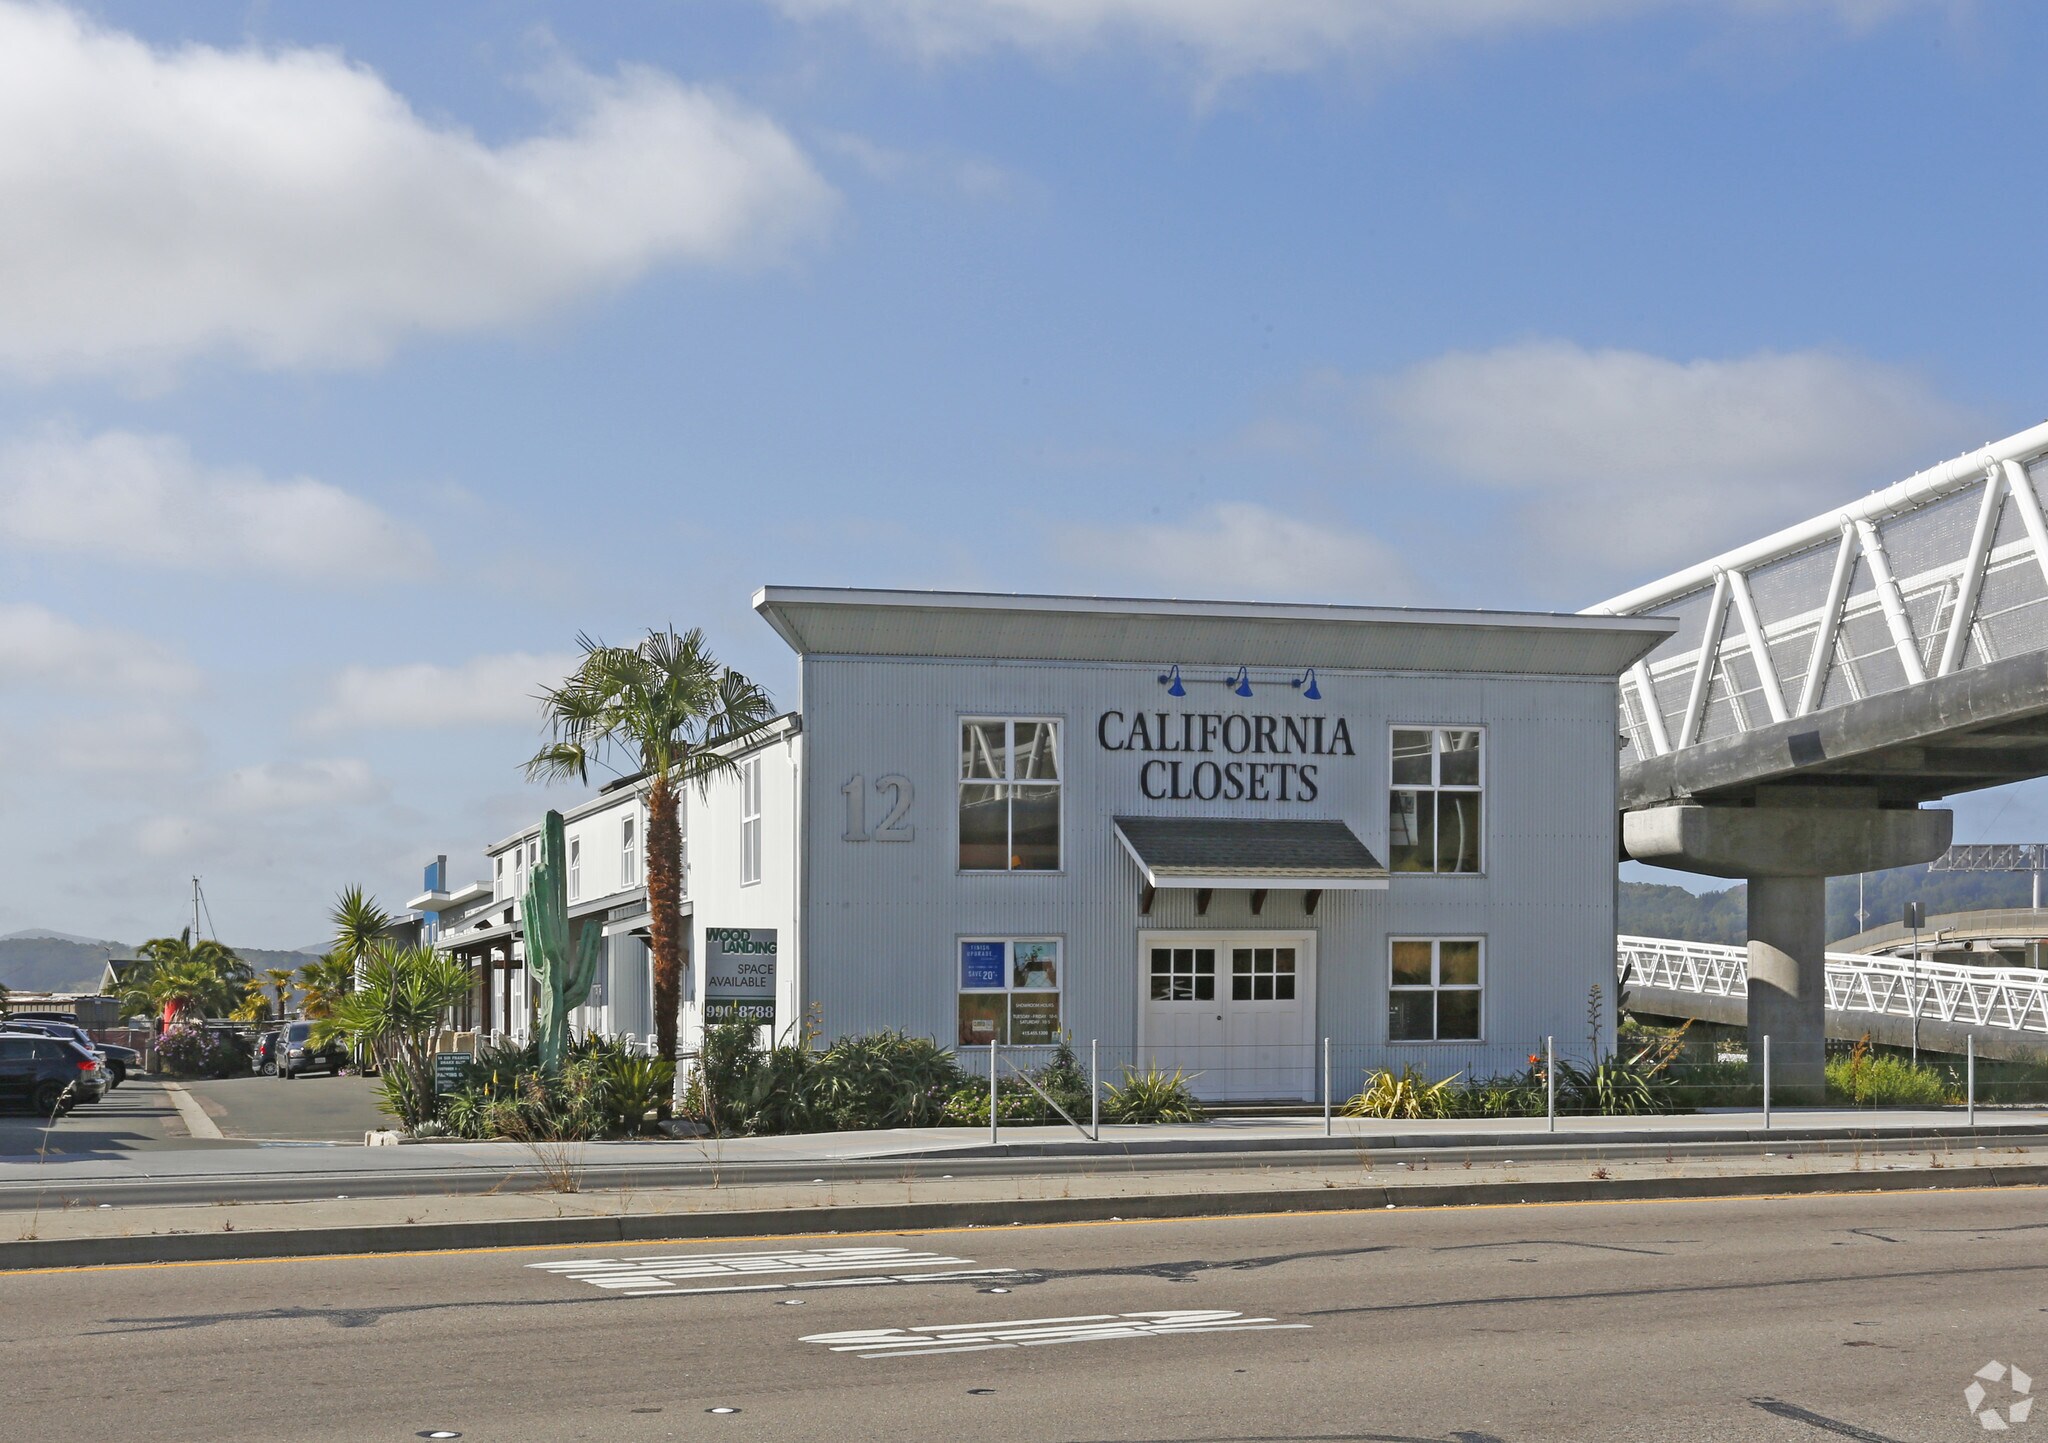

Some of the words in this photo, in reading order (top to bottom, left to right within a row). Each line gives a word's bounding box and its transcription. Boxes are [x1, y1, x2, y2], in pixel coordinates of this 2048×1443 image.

[1098, 710, 1356, 756] CALIFORNIA
[1140, 759, 1318, 802] CLOSETS
[840, 774, 915, 842] 12
[706, 928, 751, 942] WOOD
[721, 941, 777, 955] LANDING
[737, 963, 774, 975] SPACE
[708, 976, 767, 988] AVAILABLE
[706, 1005, 774, 1018] 990-8788
